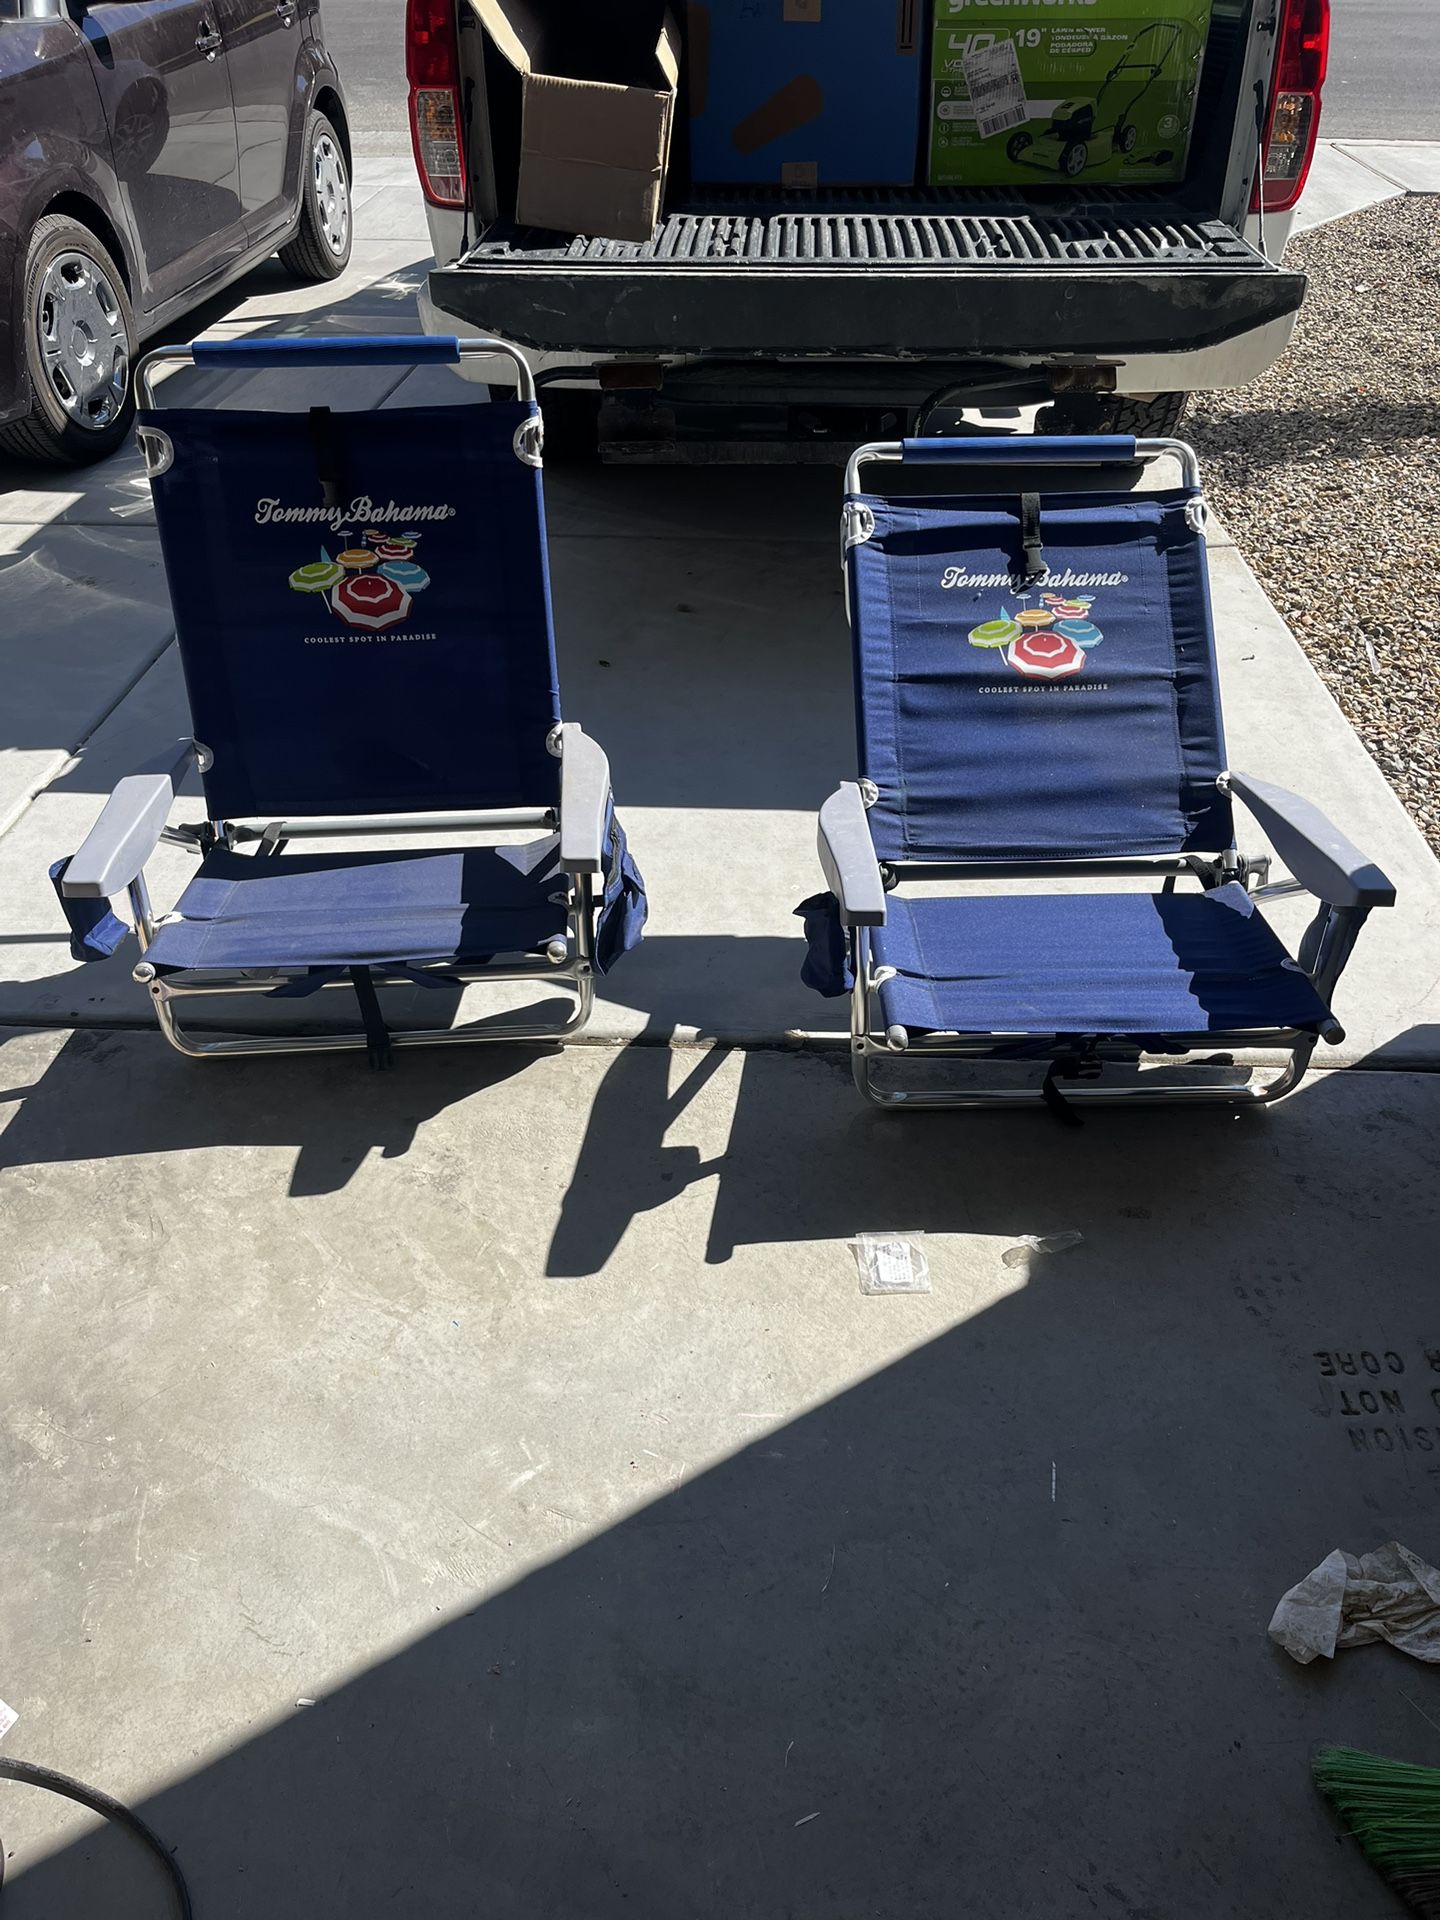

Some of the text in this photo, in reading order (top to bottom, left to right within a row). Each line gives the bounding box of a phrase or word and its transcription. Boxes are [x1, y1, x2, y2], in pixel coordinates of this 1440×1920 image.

[254, 498, 346, 531] Tommy
[940, 566, 1024, 595] Tommy
[304, 636, 346, 644] COOLEST
[390, 633, 437, 642] PARADISE
[978, 686, 1019, 694] COOLEST
[1063, 683, 1109, 692] PARADISE
[1313, 1351, 1405, 1376] CORE
[1340, 1389, 1406, 1416] NOT
[1348, 1426, 1440, 1452] SION
